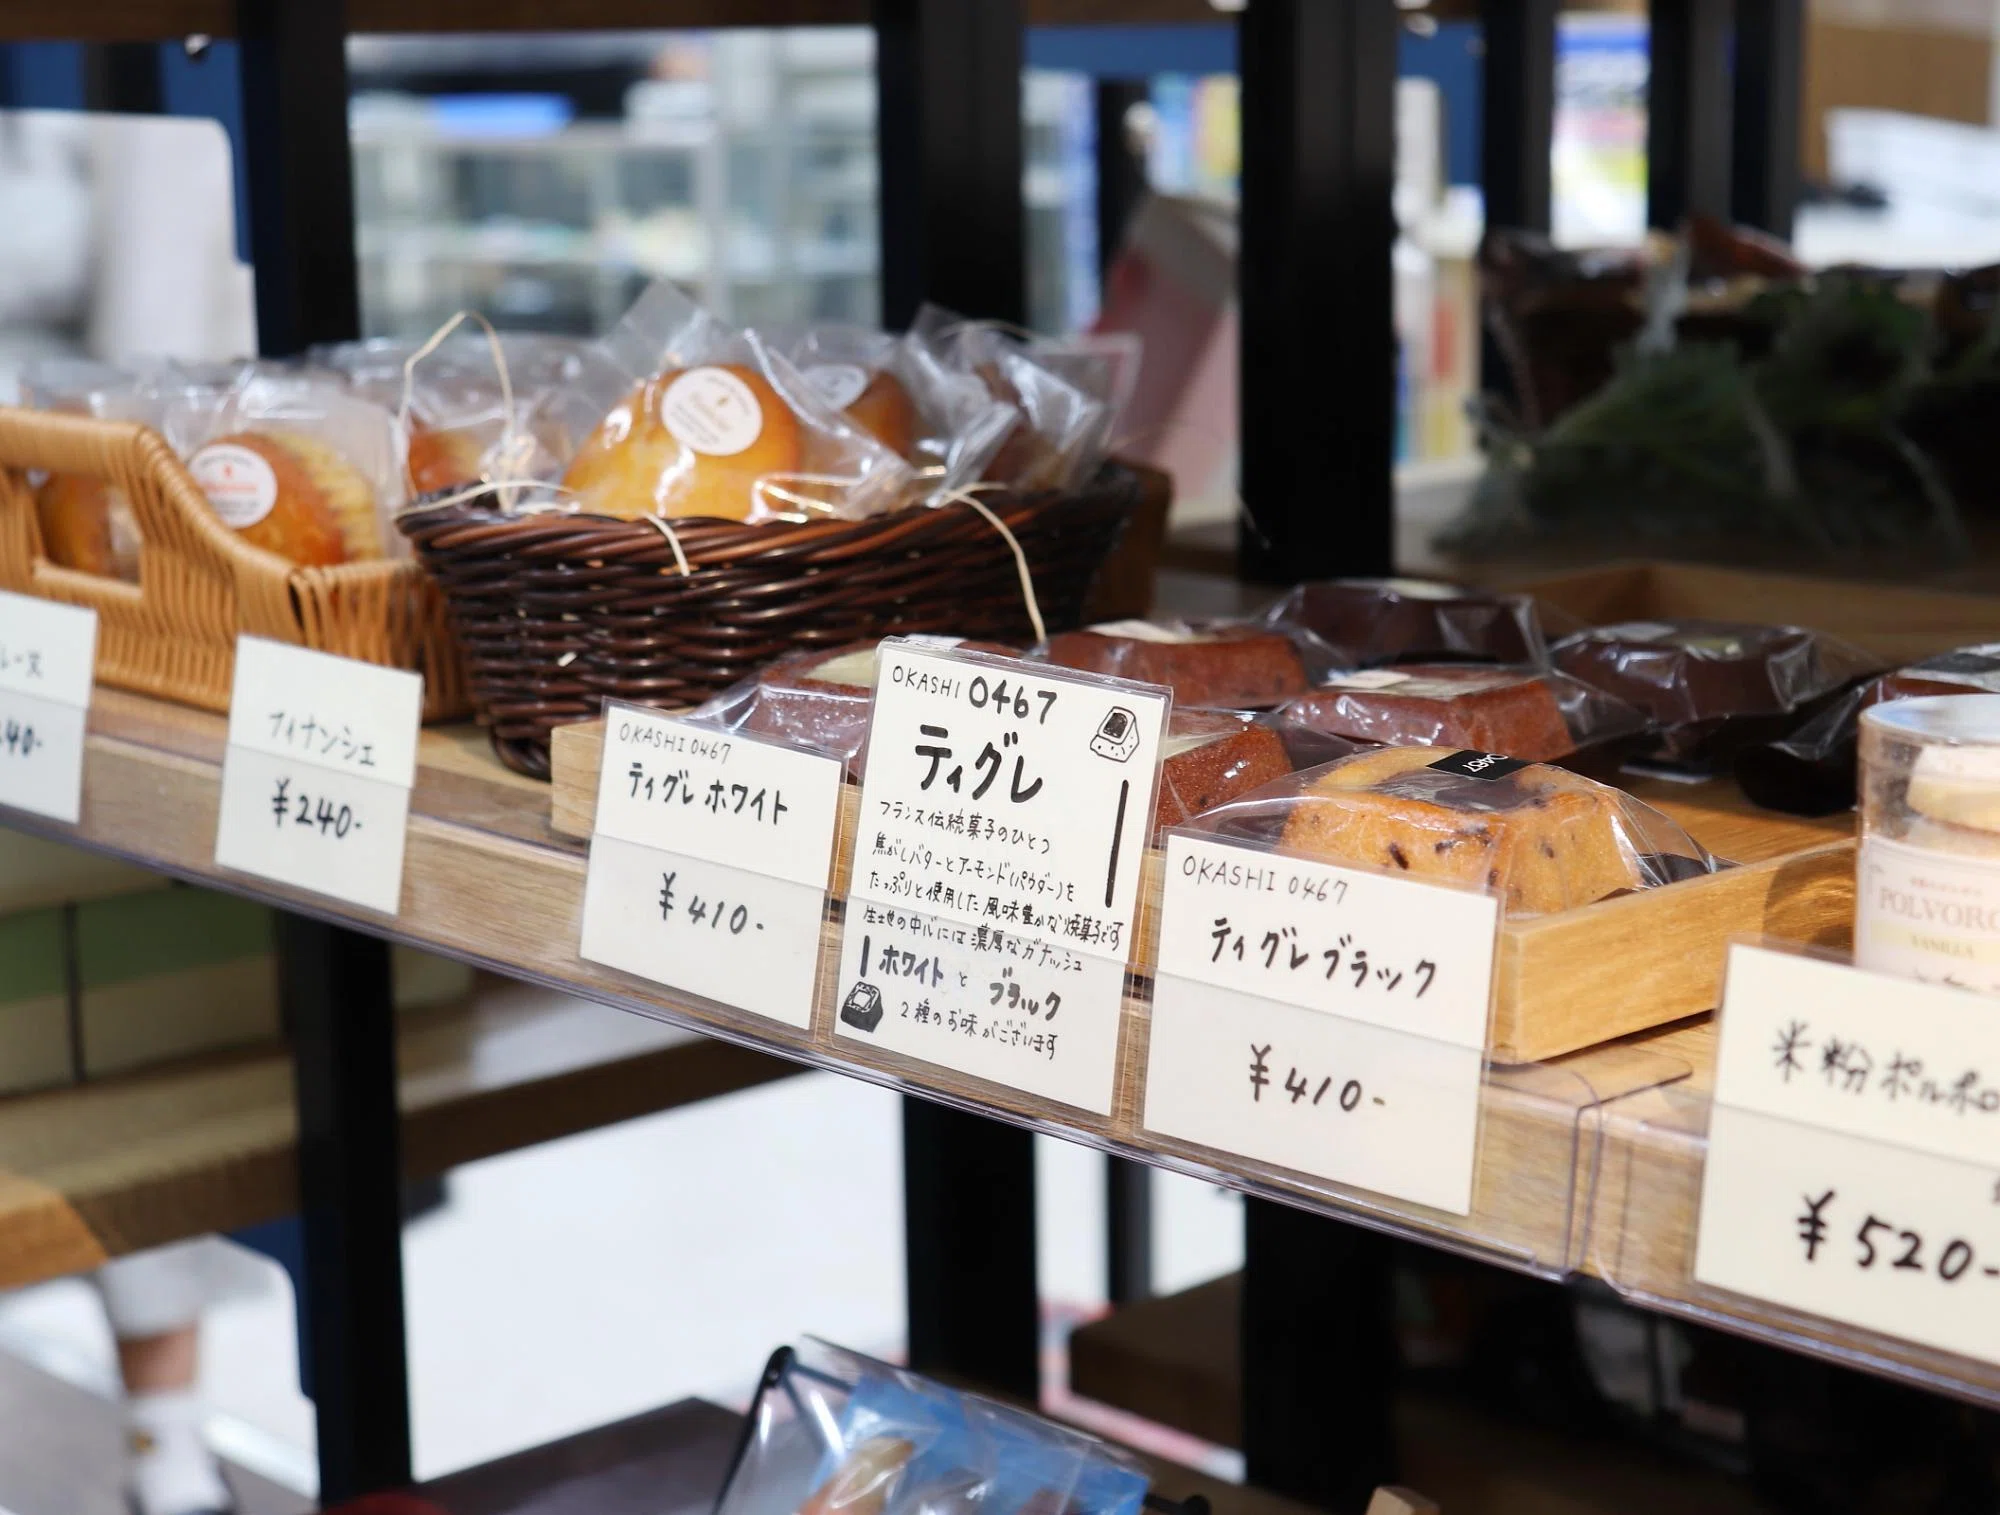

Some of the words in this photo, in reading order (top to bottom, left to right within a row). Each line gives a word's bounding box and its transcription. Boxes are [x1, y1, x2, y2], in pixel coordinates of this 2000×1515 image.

[892, 665, 960, 699] OKASHI
[968, 676, 1058, 725] 0467
[268, 712, 376, 767] フィナンシェ
[619, 723, 685, 753] OKASHI
[690, 741, 731, 765] 0467
[914, 723, 1043, 804] ティグレ
[879, 800, 1051, 855] フランス伝統菓子のひとつ
[1182, 855, 1276, 893] OKASHI
[1288, 879, 1348, 905] 0467
[878, 944, 945, 988] ホワイト
[958, 970, 969, 988] と
[988, 966, 1062, 1021] ブラック
[900, 1000, 1059, 1061] 2種のお味がございます
